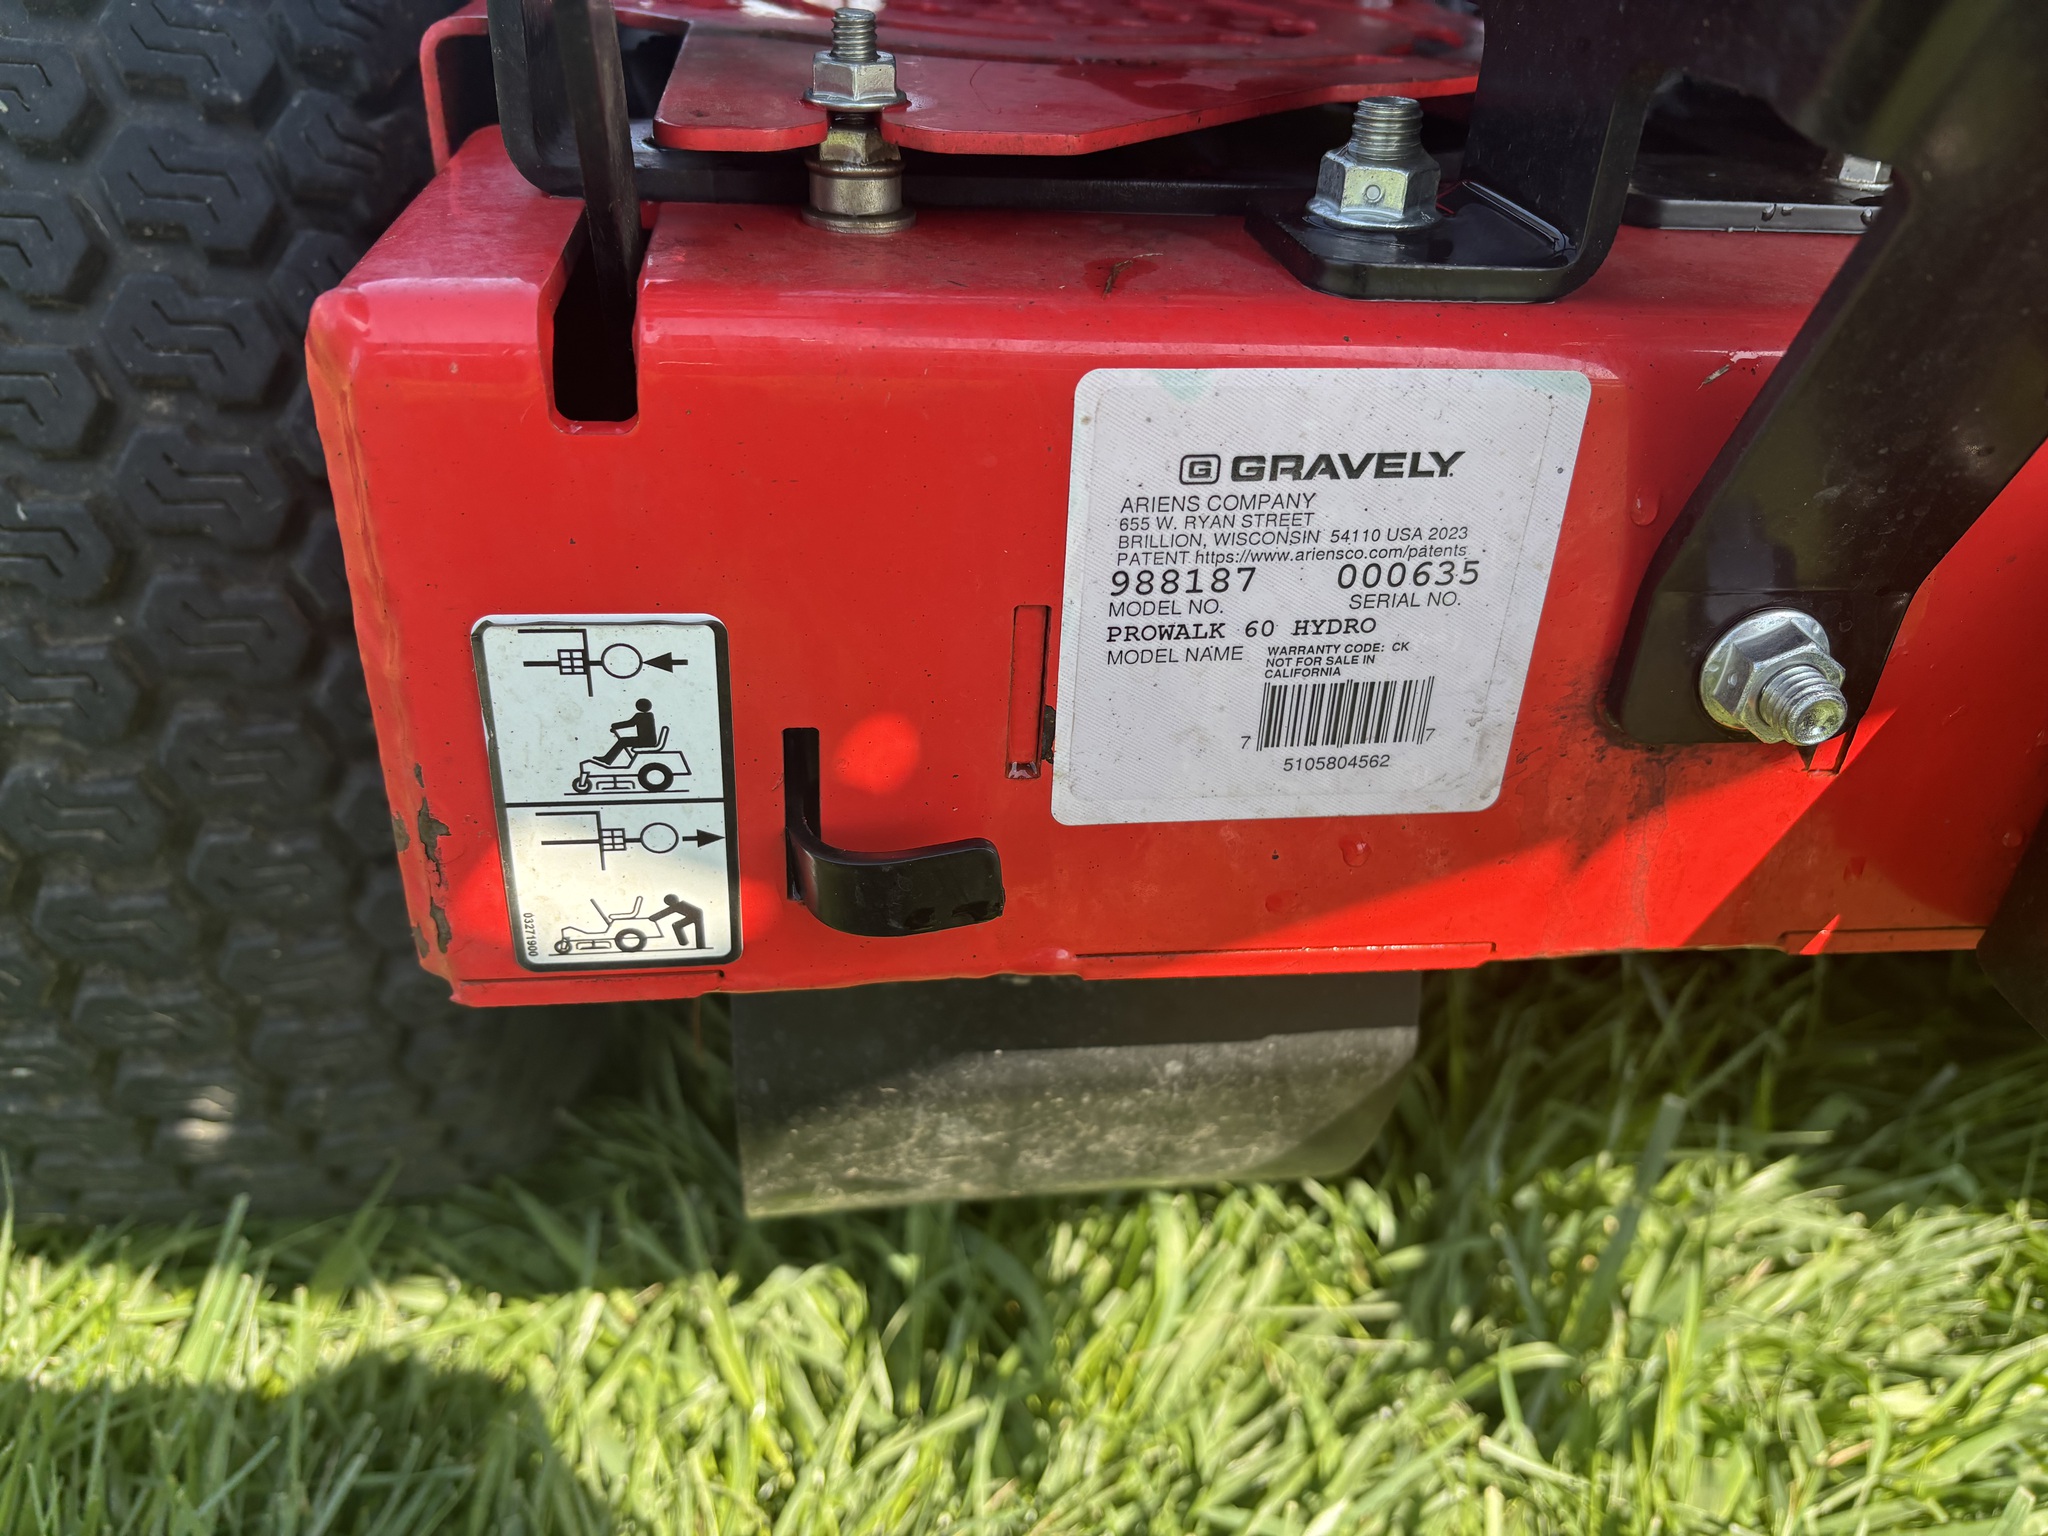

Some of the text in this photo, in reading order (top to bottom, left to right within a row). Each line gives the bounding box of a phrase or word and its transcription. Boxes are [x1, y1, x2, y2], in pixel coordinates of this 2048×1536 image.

[1231, 451, 1466, 482] GRAVELY
[1120, 492, 1317, 514] ARIENS COMPANY
[1119, 512, 1315, 531] 655 W. RYAN STREET
[1118, 526, 1469, 550] BRILLION, WISCONSIN 54110 USA 2023
[1194, 544, 1467, 565] https://www.ariensco.com/patents
[1111, 566, 1257, 597] 988187
[1337, 560, 1480, 589] 000635
[1109, 598, 1224, 617] MODEL NO.
[1349, 591, 1462, 610] SERIAL NO.
[1106, 617, 1377, 642] PROWALK 60 HYDRO
[1107, 645, 1244, 666] MODEL NAME
[1267, 641, 1410, 656] WARRANTY CODE: CK
[1265, 654, 1375, 668] NOT FOR SALE IN
[1264, 665, 1341, 679] CALIFORNIA
[1240, 735, 1251, 750] 7
[1424, 728, 1436, 742] 7
[1283, 754, 1391, 772] 5105804562
[523, 912, 539, 957] 03271900
